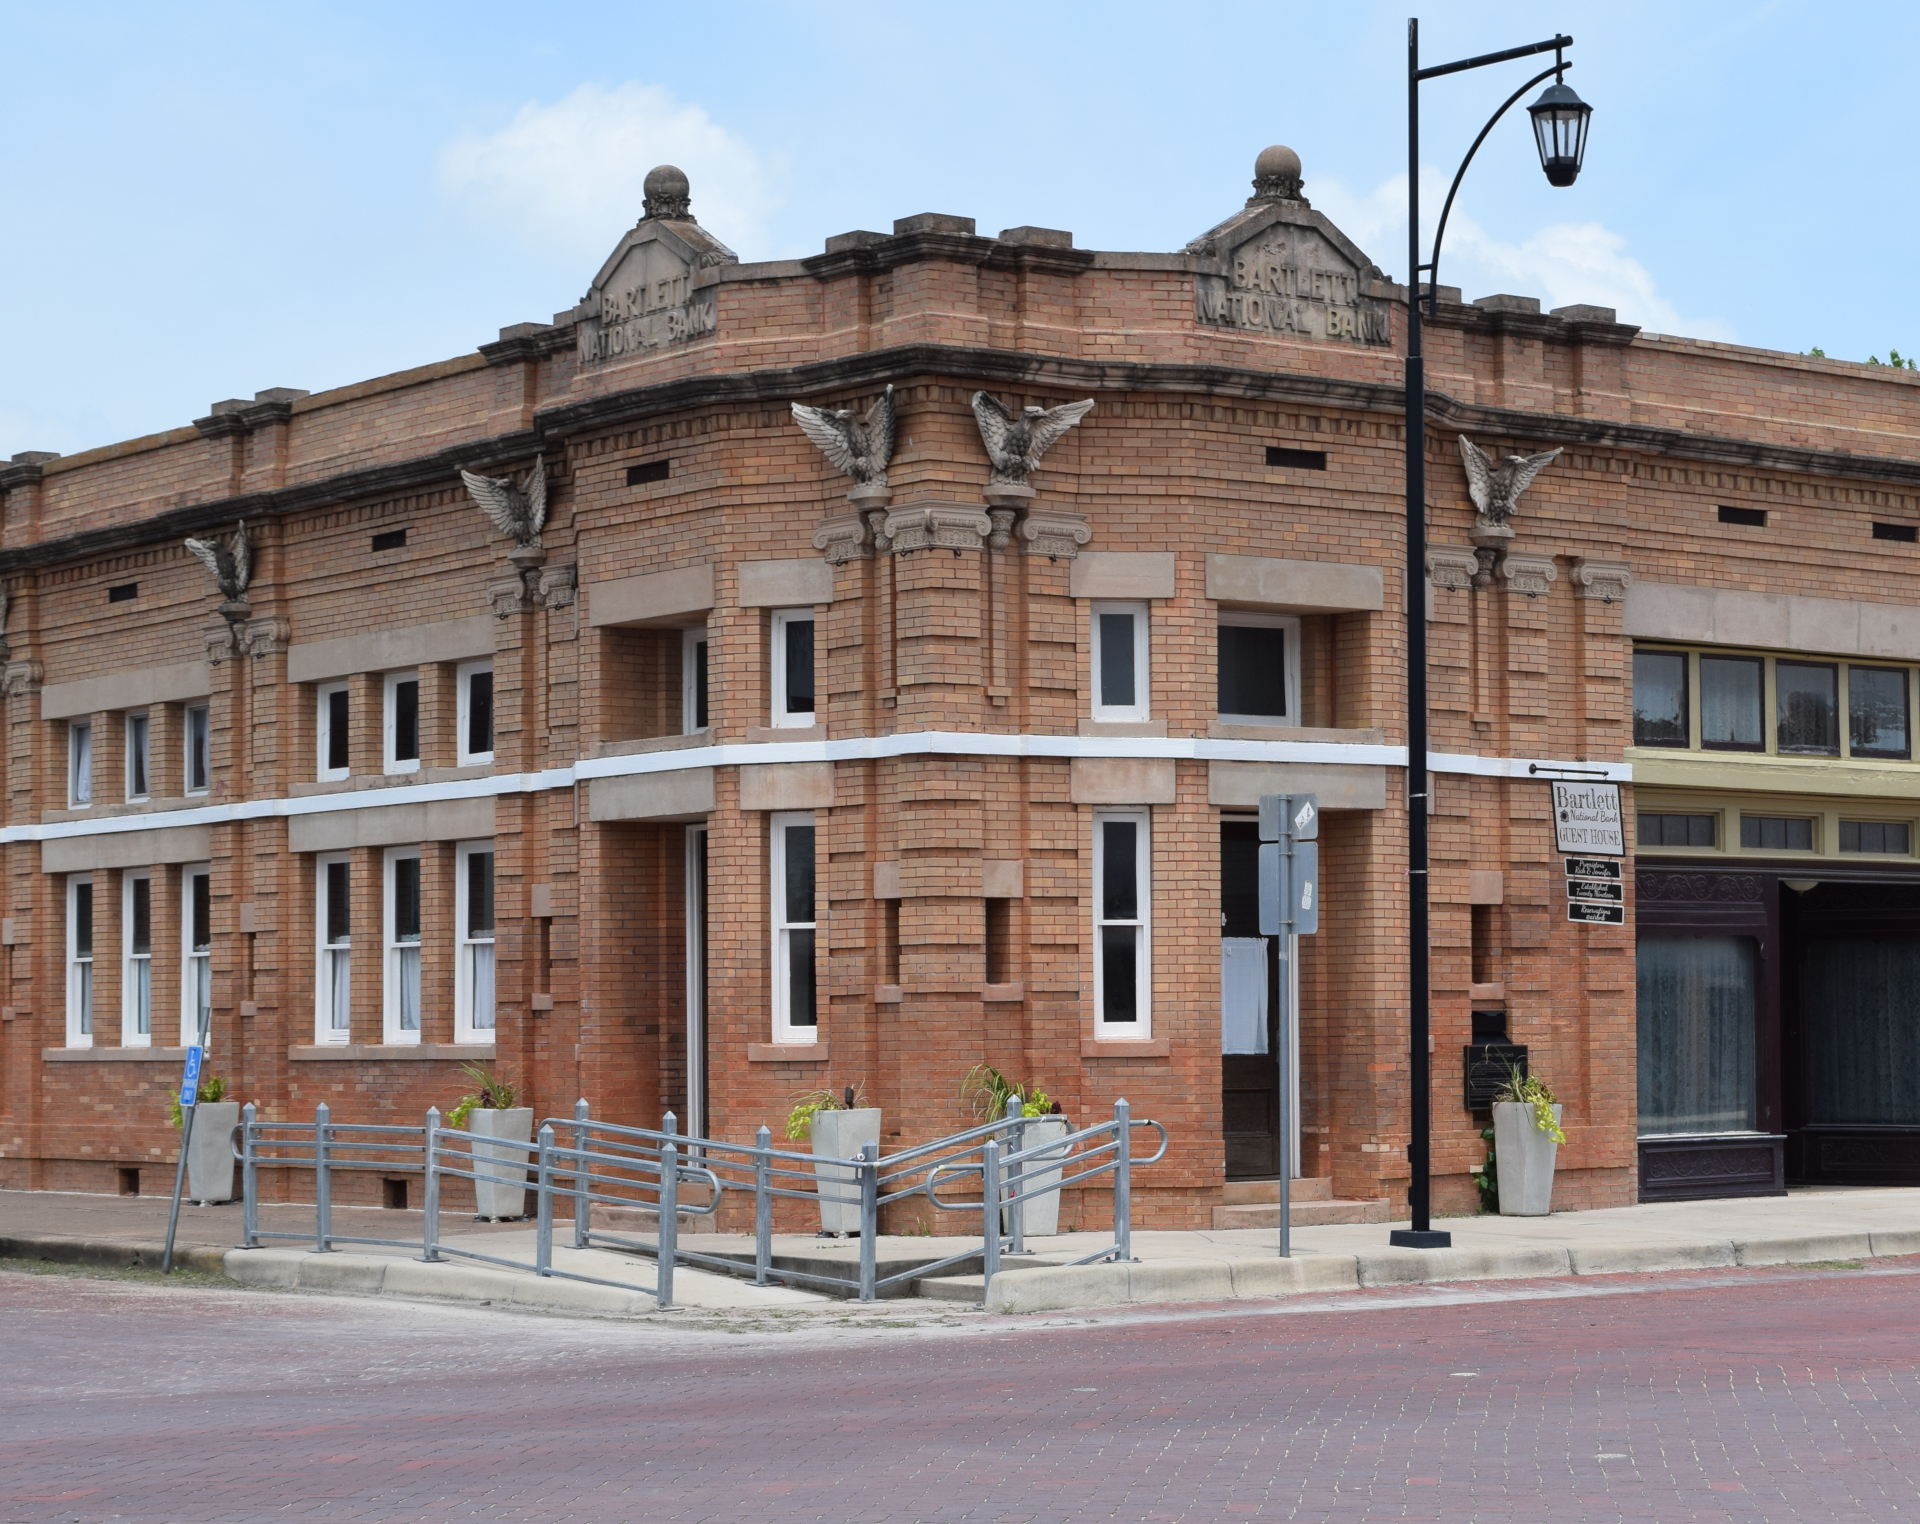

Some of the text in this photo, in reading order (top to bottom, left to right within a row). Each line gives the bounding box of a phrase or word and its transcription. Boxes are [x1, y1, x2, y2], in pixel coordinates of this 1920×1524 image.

[1233, 260, 1357, 306] BARTLETT
[602, 271, 691, 325] BARTLETT
[1196, 290, 1390, 342] NATIONAL BANK
[579, 302, 716, 363] NATIONAL BANK
[1555, 786, 1618, 811] Bartlett
[1570, 809, 1618, 823] National Bank
[1559, 827, 1620, 846] GUEST HOUSE
[1592, 868, 1611, 877] Jennifer
[1576, 888, 1614, 898] Twenty Nineteen
[1581, 883, 1608, 891] Established
[1581, 905, 1611, 915] Reservations
